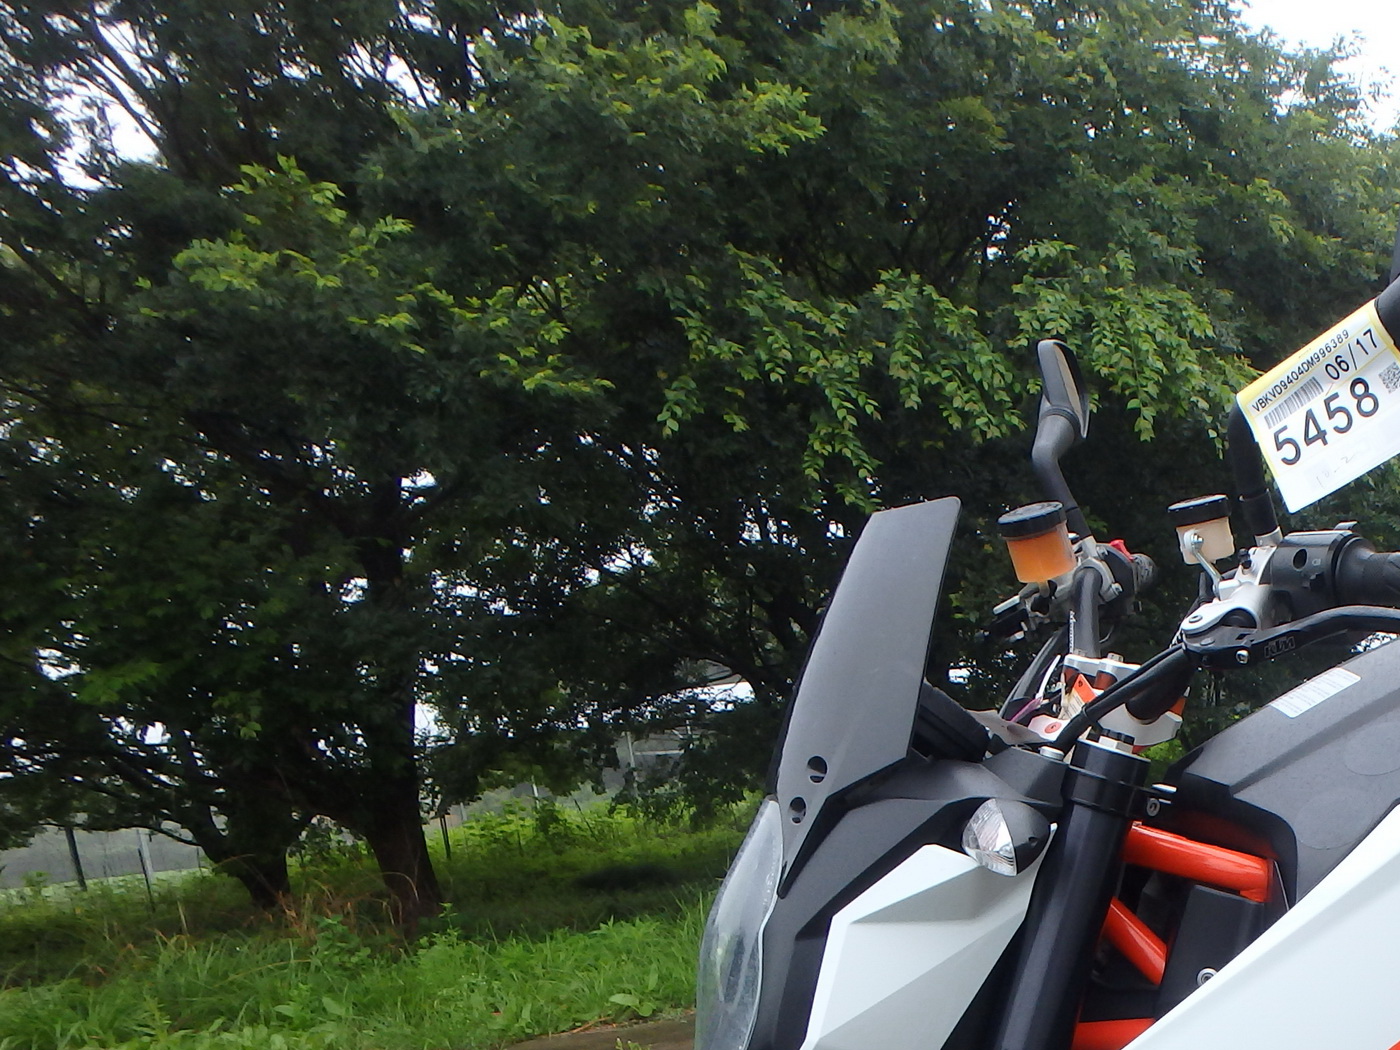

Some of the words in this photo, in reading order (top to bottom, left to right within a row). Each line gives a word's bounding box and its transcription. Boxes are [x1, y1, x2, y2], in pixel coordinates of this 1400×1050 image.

[1252, 329, 1350, 413] VBKVD9404DM996389
[1324, 328, 1379, 381] 06/17
[1273, 377, 1380, 466] 5458
